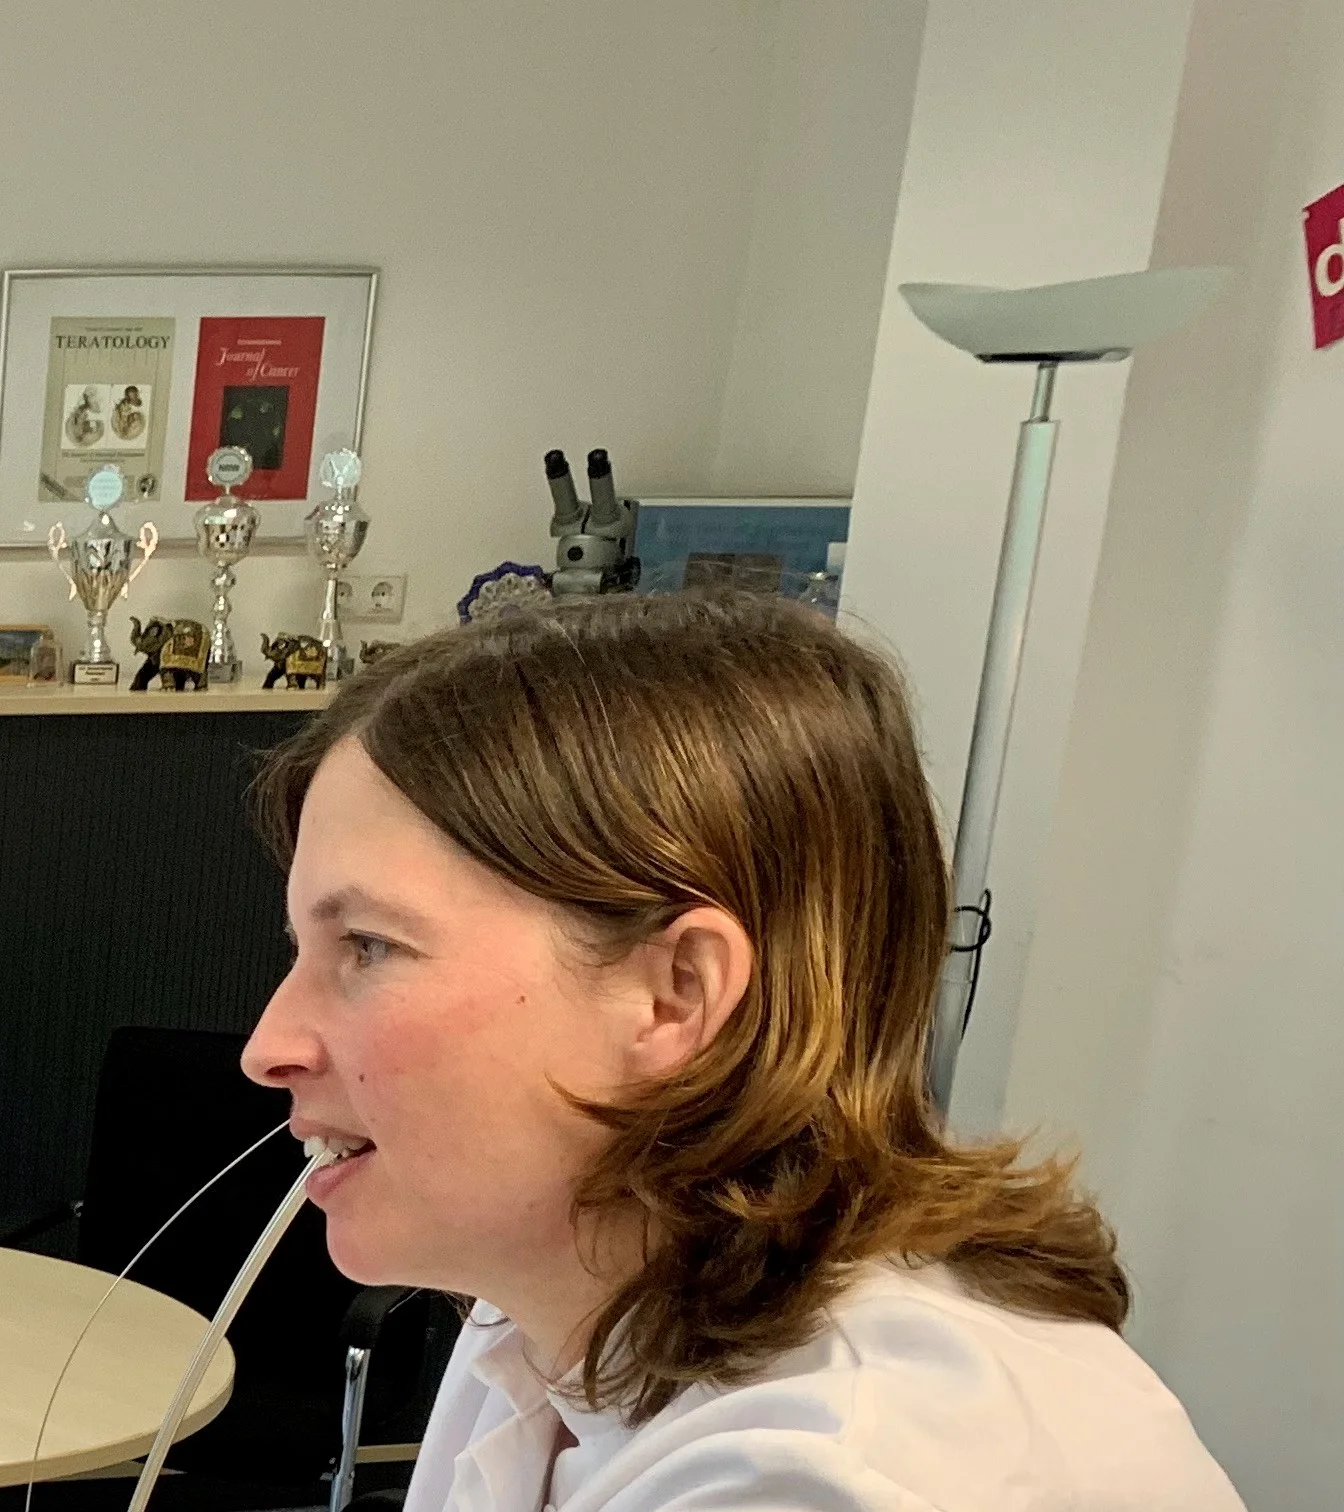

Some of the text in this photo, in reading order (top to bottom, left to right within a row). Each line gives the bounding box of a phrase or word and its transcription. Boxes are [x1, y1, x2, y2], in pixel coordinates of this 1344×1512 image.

[56, 335, 170, 349] TERATOLOGY
[214, 347, 265, 366] Journal
[260, 363, 300, 377] Cancer
